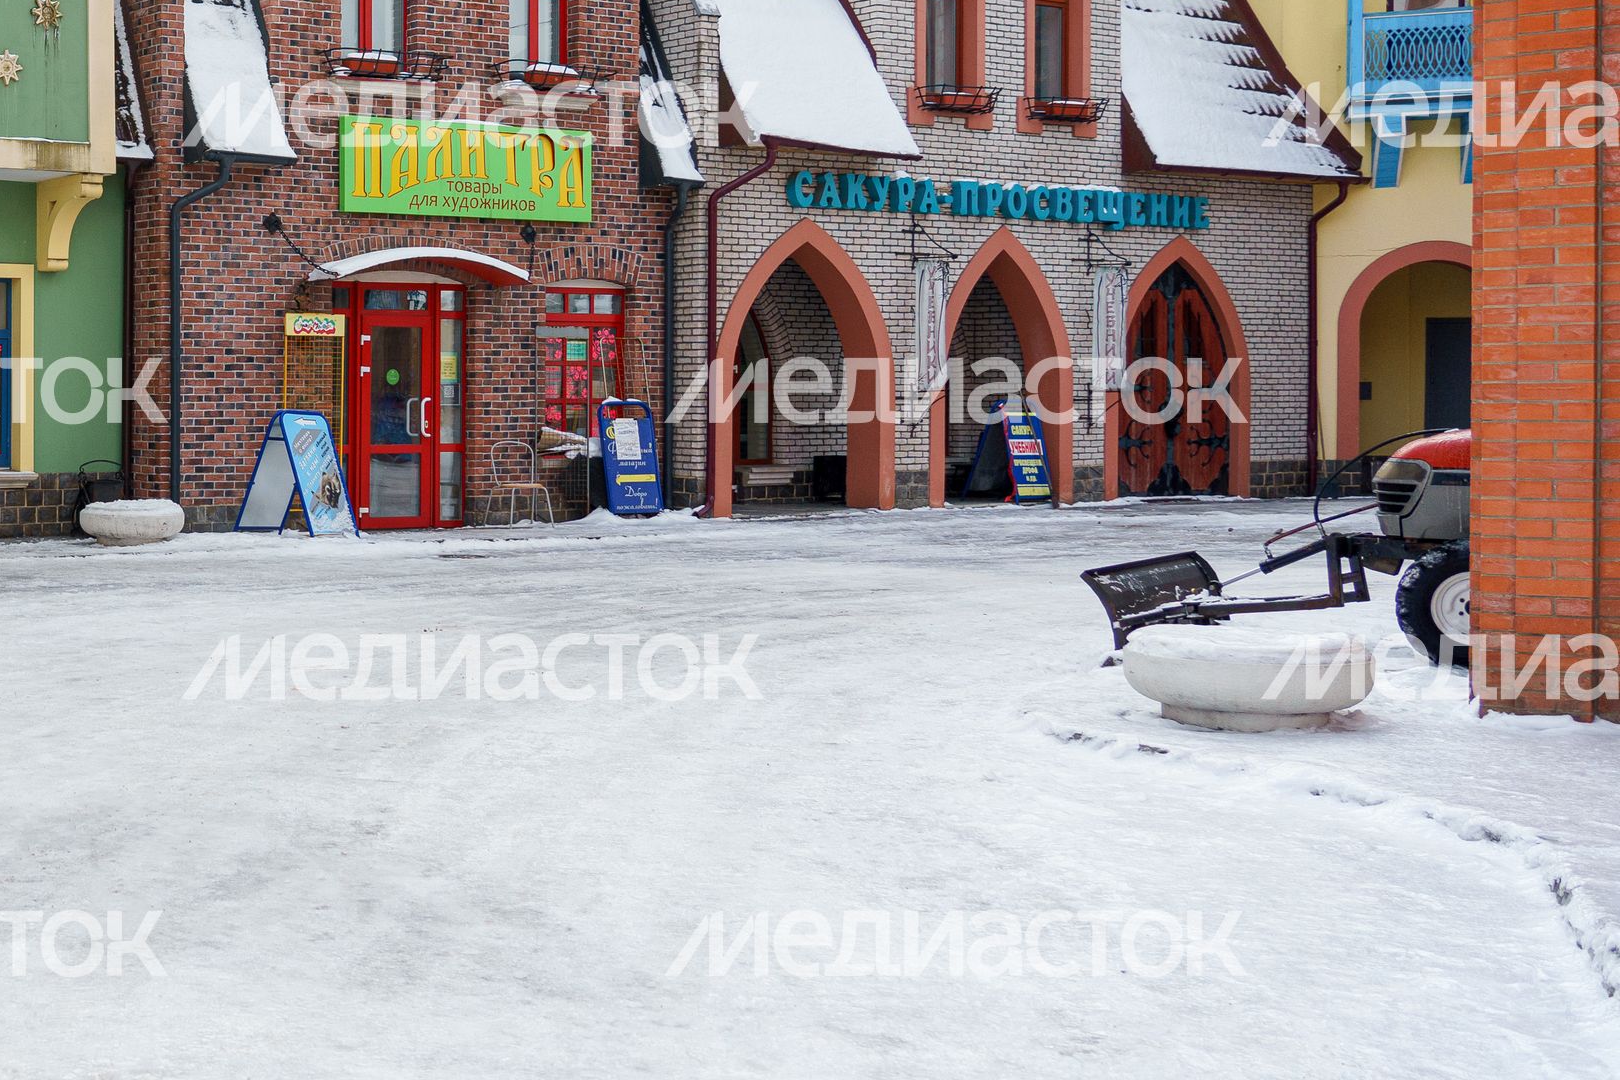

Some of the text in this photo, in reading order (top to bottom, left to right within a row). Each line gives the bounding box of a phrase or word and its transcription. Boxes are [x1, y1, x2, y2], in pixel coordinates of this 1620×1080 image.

[351, 122, 586, 208] ПАЛИТРА
[447, 180, 502, 197] товары
[409, 194, 536, 212] для художников
[788, 170, 1210, 230] САКУРА-ПРОСВЕЩЕНИЕ
[1105, 272, 1116, 385] УЧЕБНИКИ
[1011, 425, 1034, 435] САКУР
[618, 461, 646, 469] магазин
[624, 485, 647, 502] Добро
